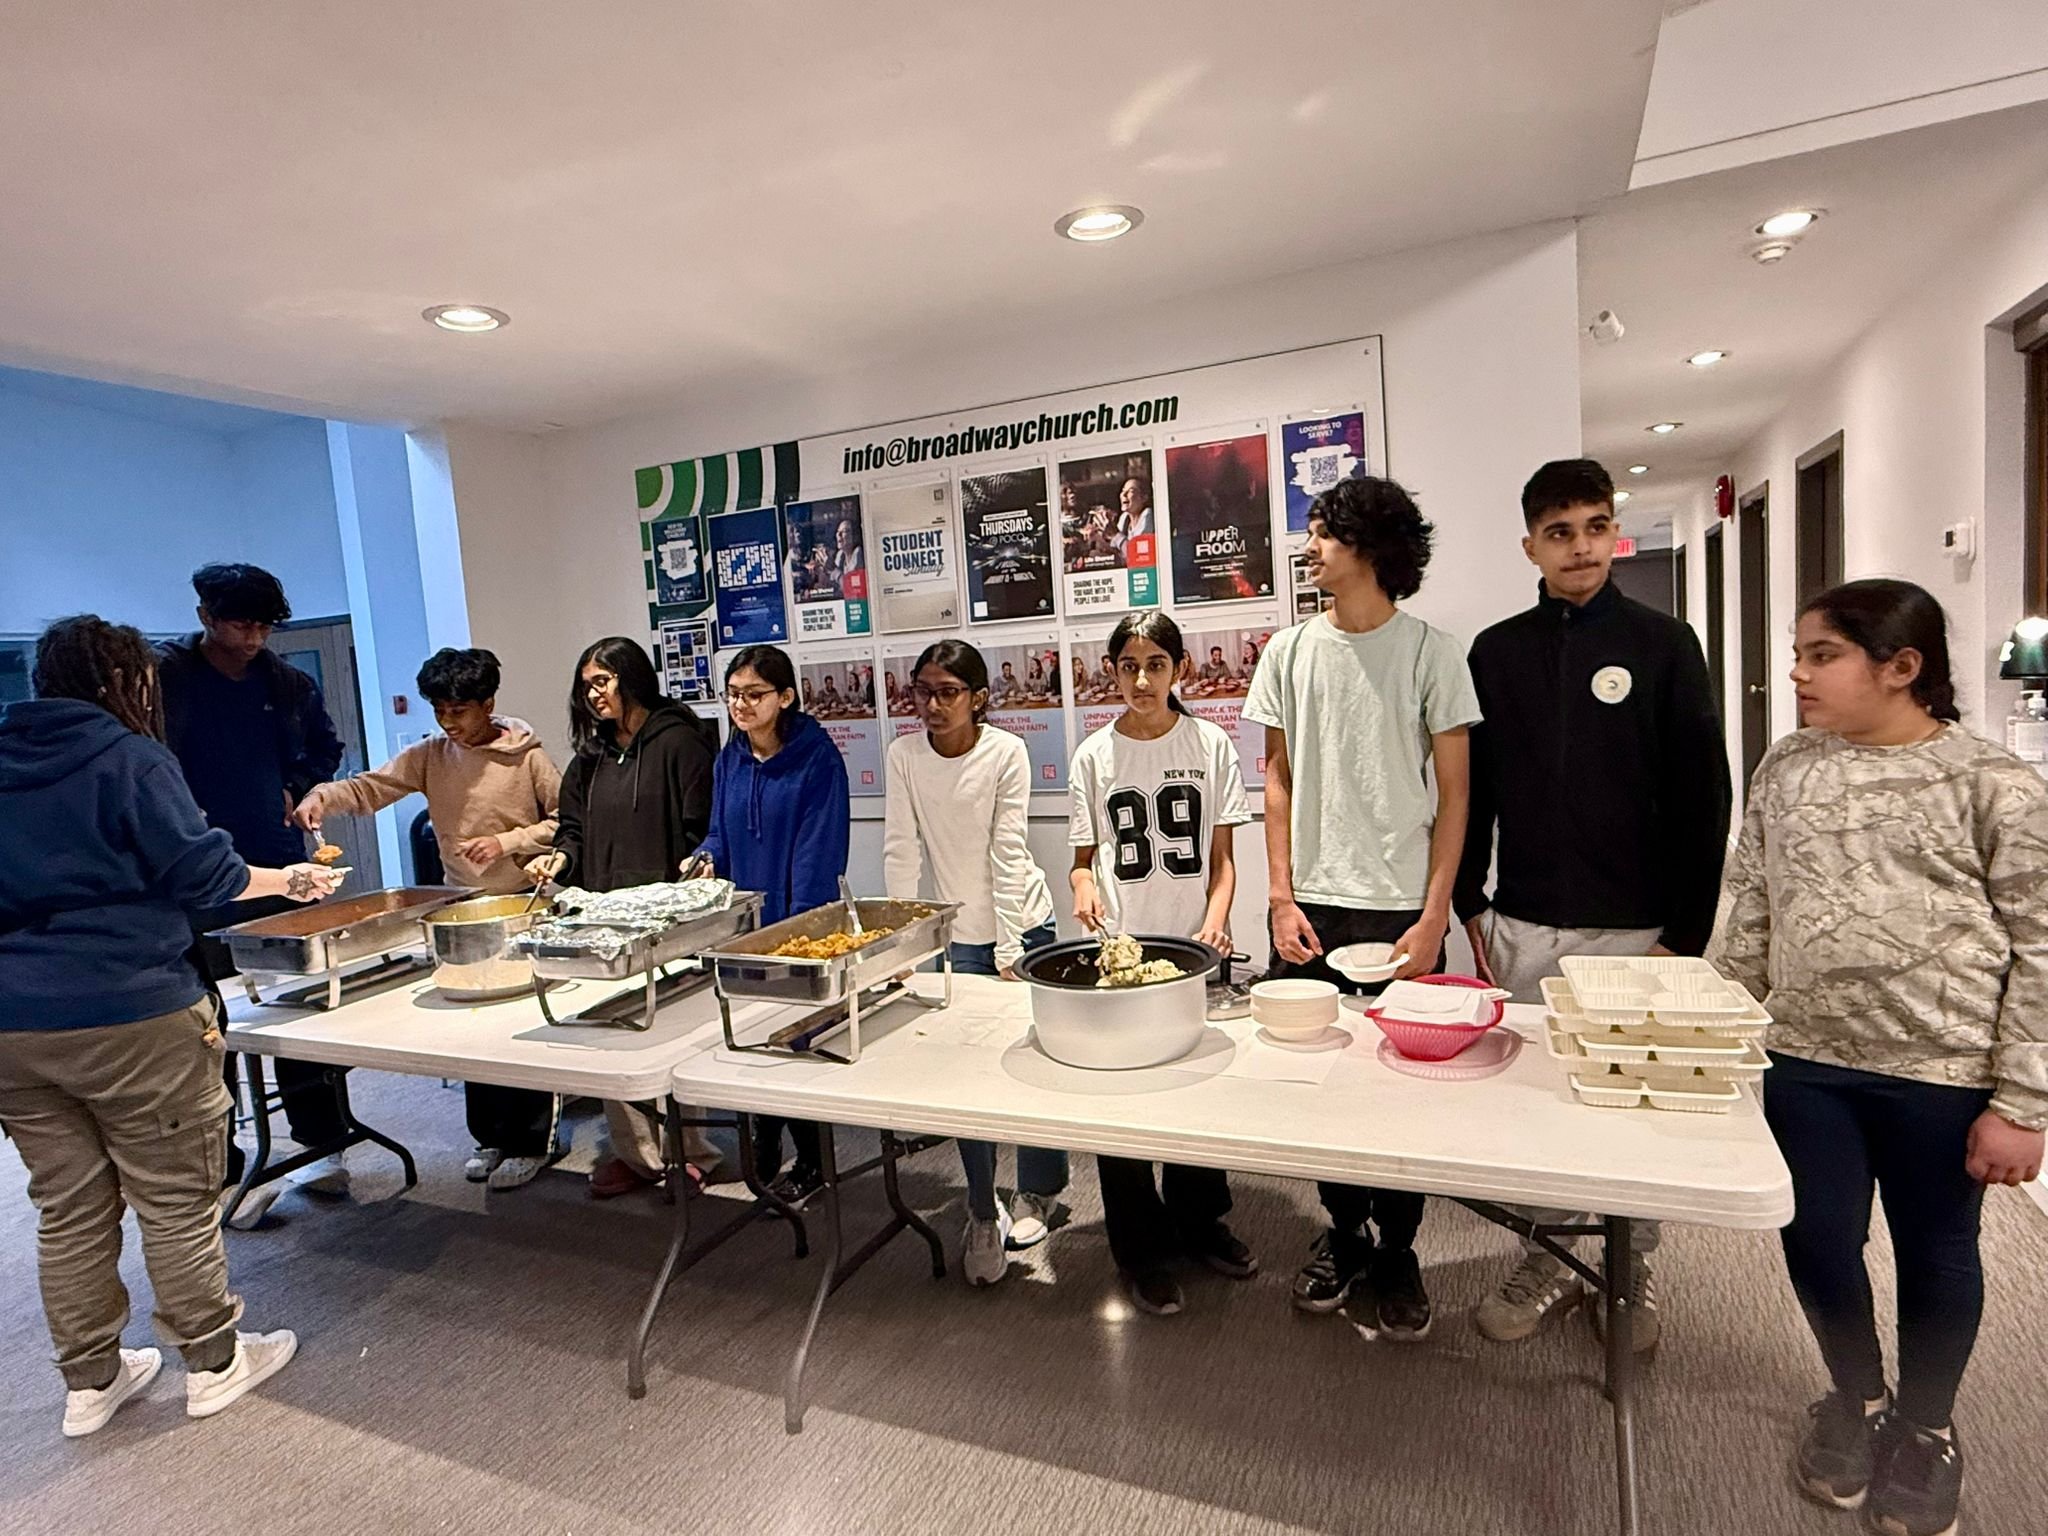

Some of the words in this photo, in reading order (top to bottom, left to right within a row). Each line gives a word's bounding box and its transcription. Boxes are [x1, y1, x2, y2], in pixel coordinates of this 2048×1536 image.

[843, 395, 1179, 474] info@broadwaychurch.com
[1299, 422, 1330, 434] LOOKING
[1332, 421, 1342, 429] TO
[979, 516, 1034, 536] THURSDAYS
[1201, 525, 1239, 543] UPPER
[882, 530, 943, 553] STUDENT
[1195, 539, 1246, 557] ROOM
[884, 549, 944, 571] CONNECT
[991, 716, 1015, 724] NPACK
[1026, 723, 1048, 731] FAITH
[1163, 768, 1185, 779] NEW
[1105, 780, 1203, 885] 89
